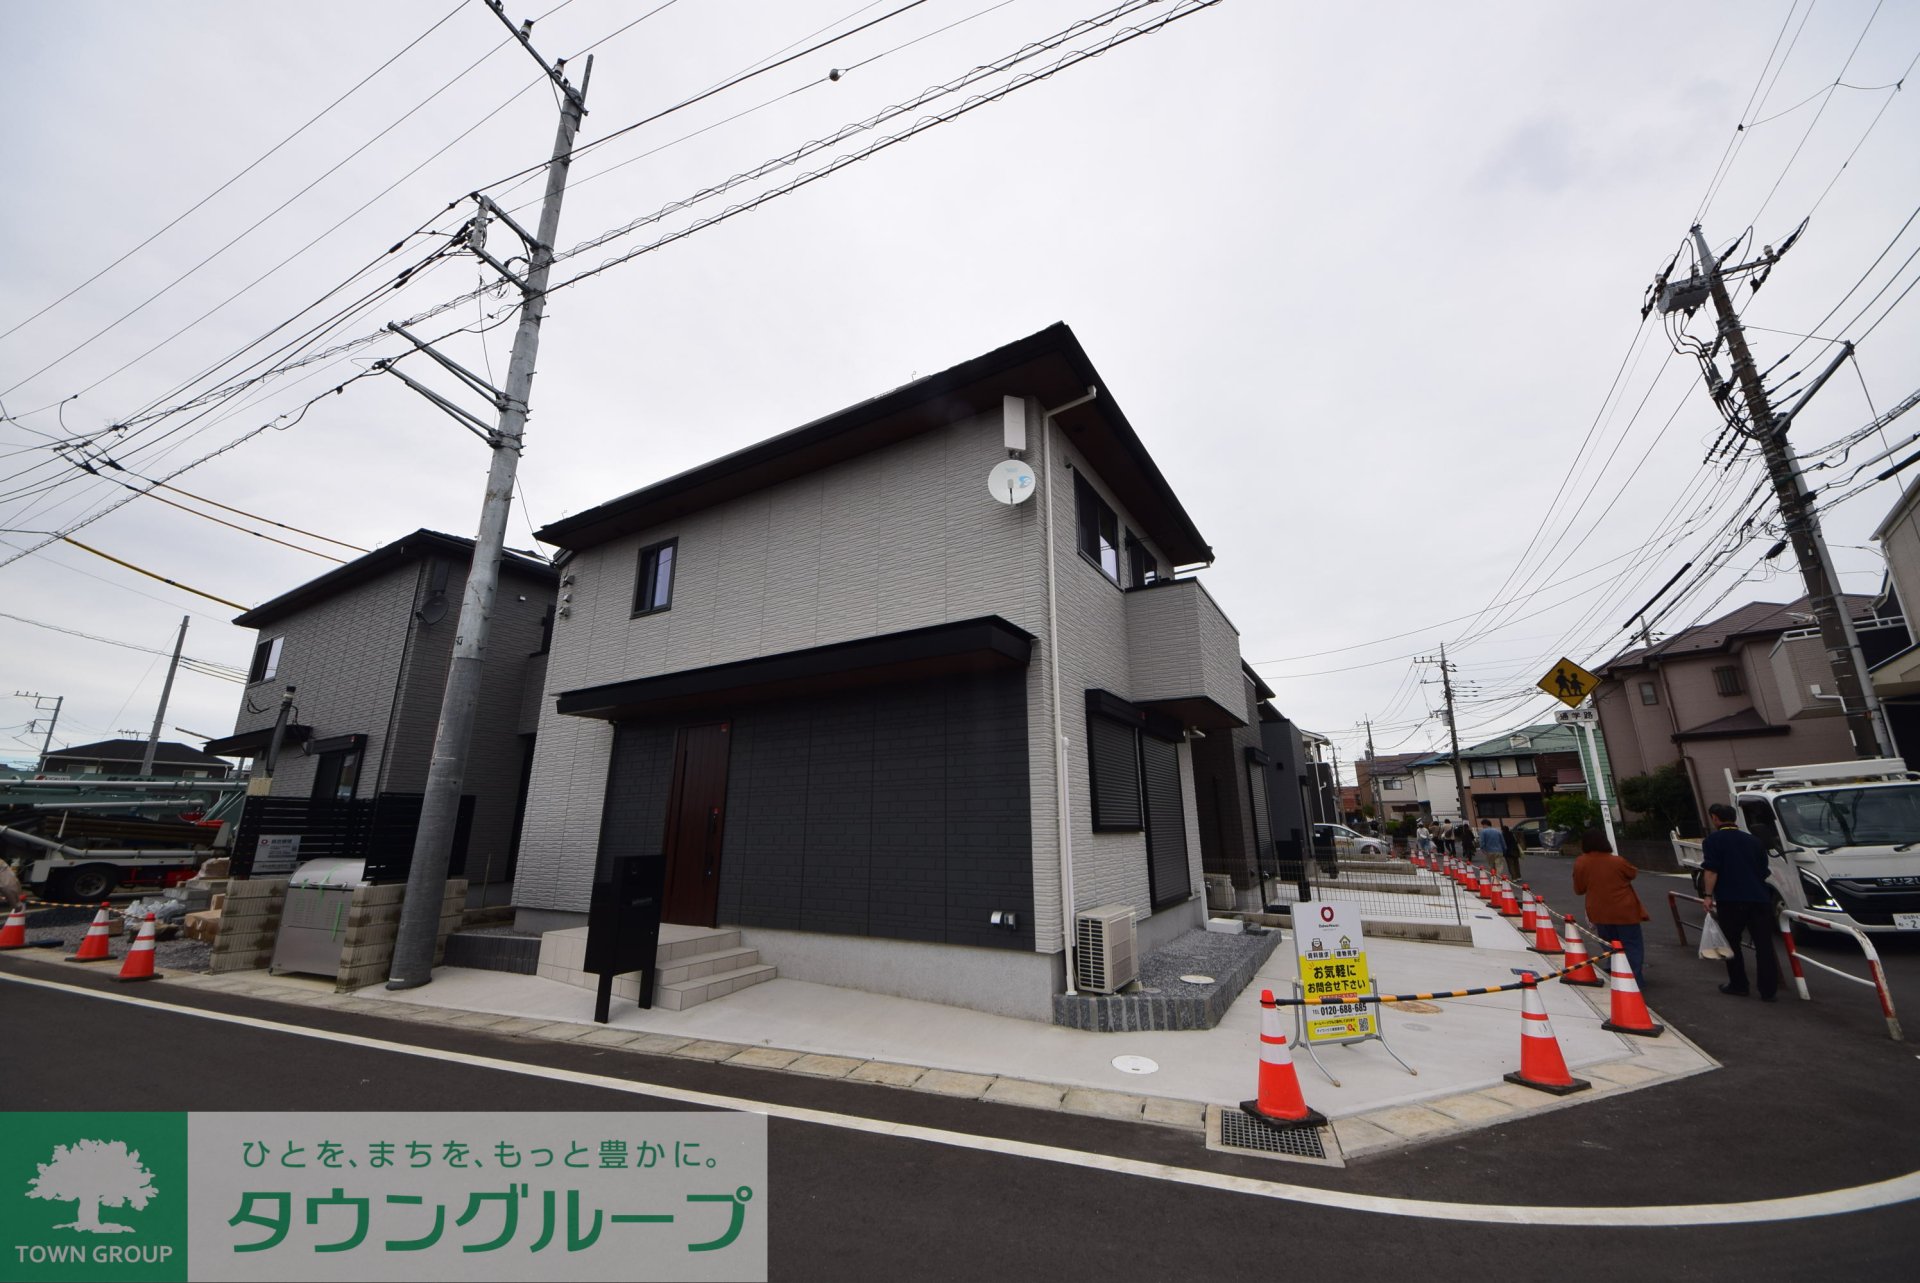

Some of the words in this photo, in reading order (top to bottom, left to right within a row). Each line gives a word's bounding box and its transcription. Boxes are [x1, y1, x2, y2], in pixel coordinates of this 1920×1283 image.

[1560, 711, 1593, 720] 通学路
[1314, 965, 1356, 979] お気軽に
[1308, 980, 1366, 993] お問合せ下さい
